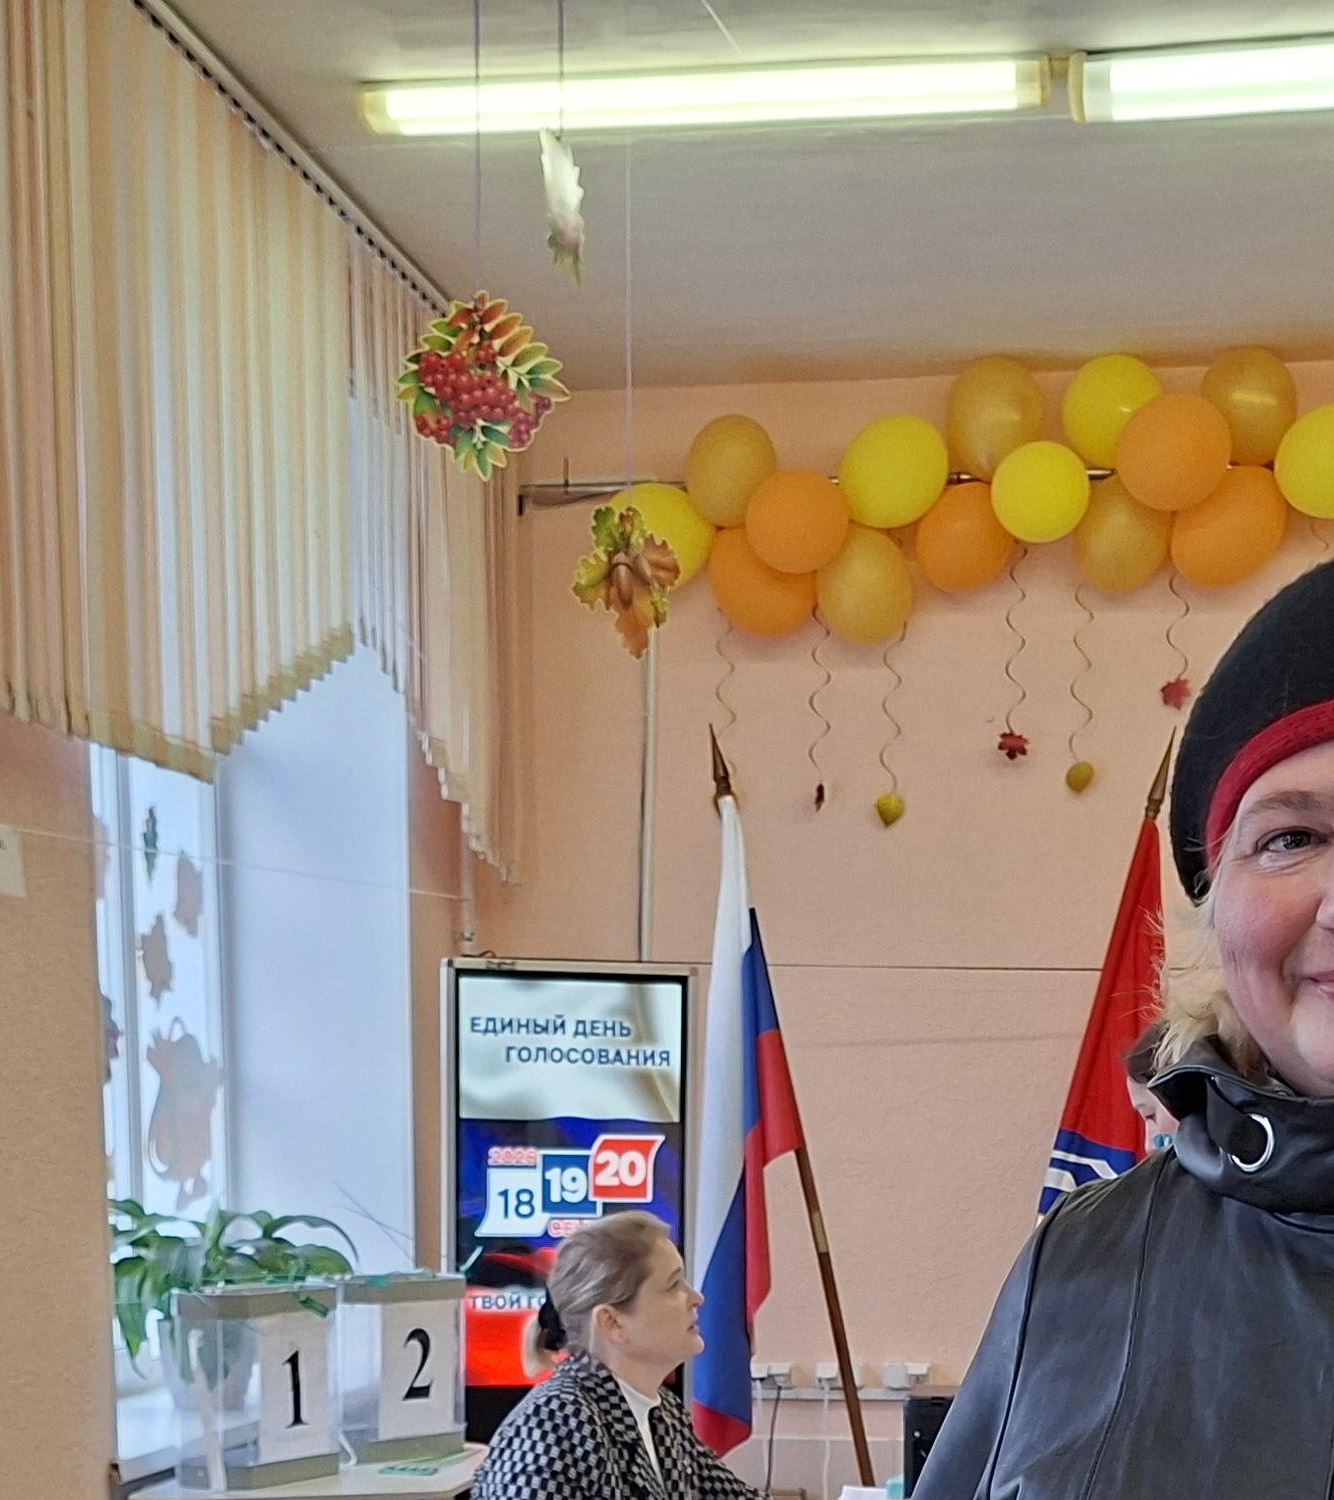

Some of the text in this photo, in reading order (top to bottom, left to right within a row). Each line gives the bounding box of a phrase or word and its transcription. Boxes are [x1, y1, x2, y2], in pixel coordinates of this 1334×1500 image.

[470, 1015, 632, 1039] ЕДИНЫЙ ДЕНЬ
[505, 1045, 671, 1067] ГОЛОСОВАНИЯ
[545, 1167, 588, 1203] 19
[595, 1151, 647, 1187] 20
[498, 1188, 536, 1219] 18
[470, 1291, 522, 1310] ТВОЙ
[402, 1327, 434, 1401] 2
[282, 1350, 310, 1428] 1
